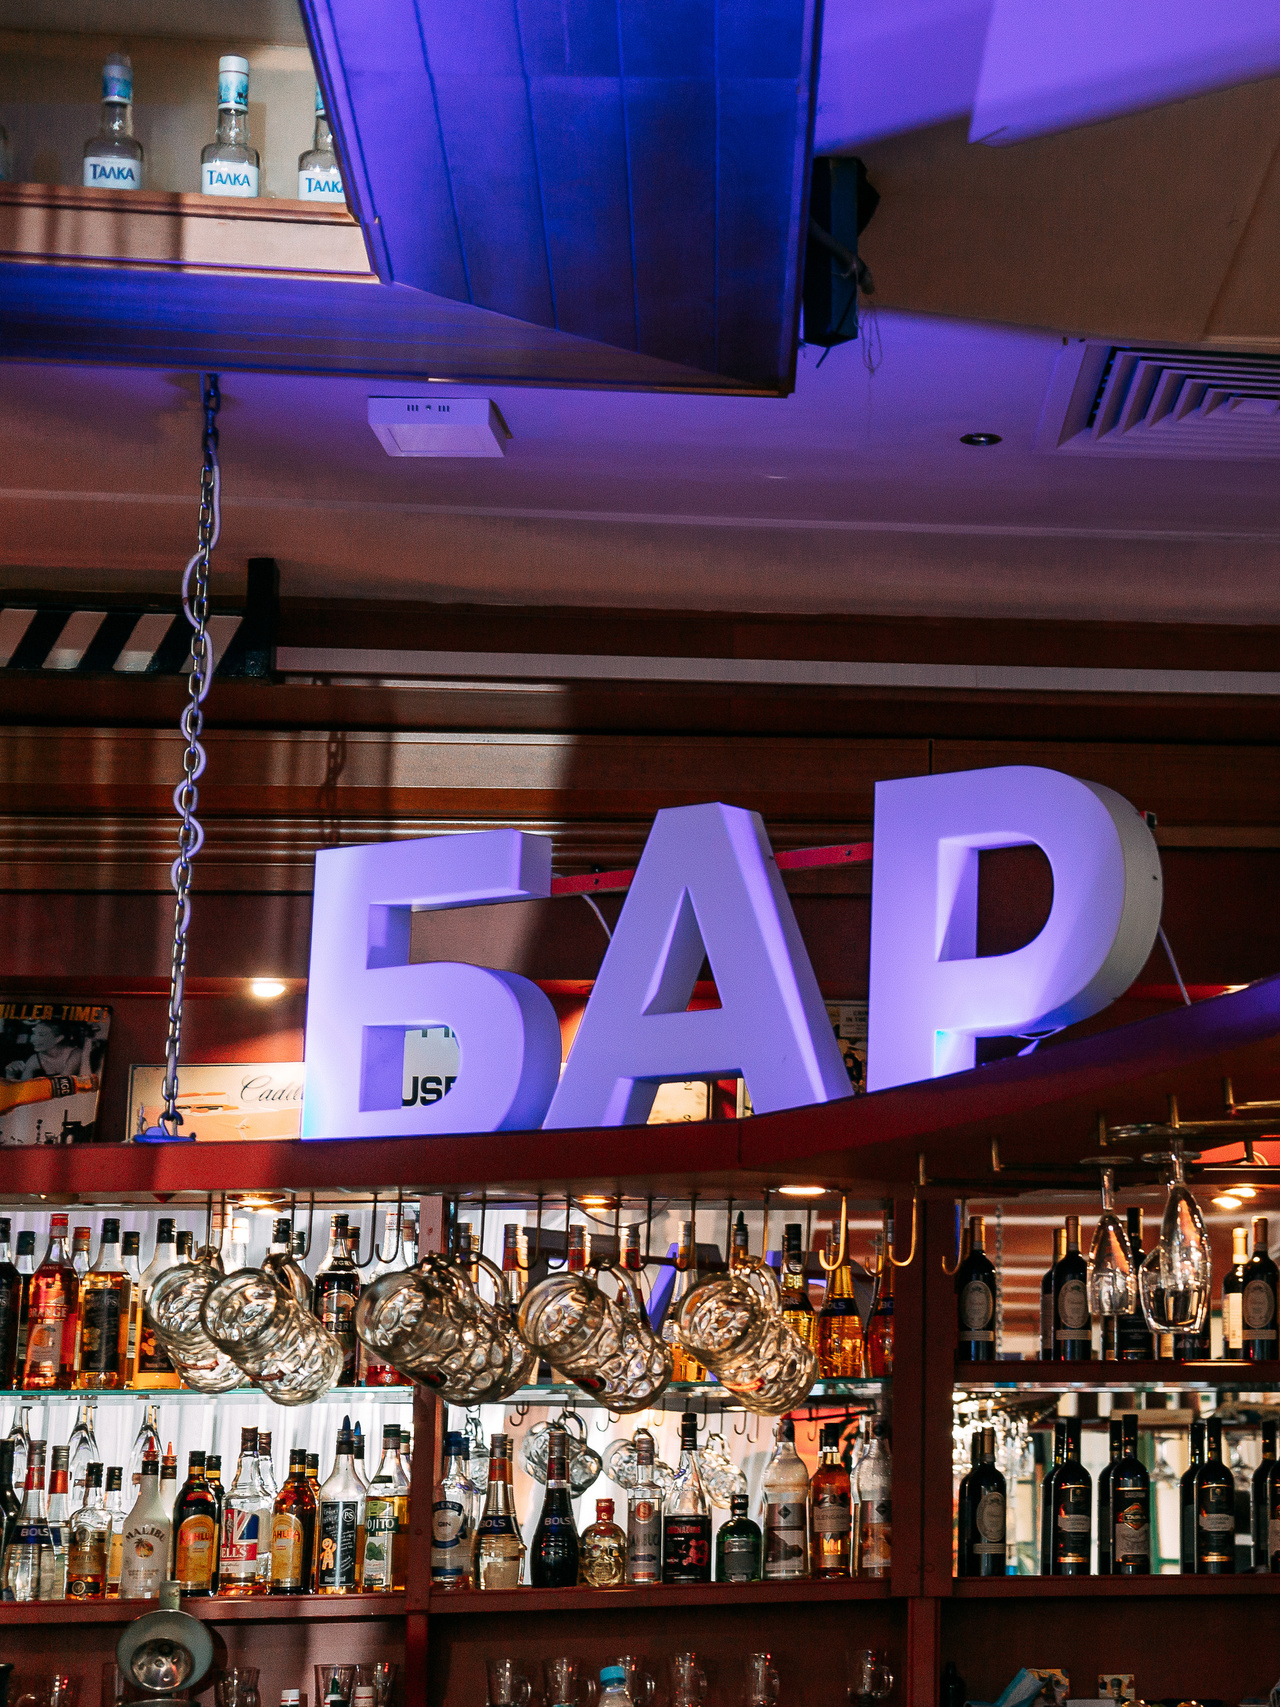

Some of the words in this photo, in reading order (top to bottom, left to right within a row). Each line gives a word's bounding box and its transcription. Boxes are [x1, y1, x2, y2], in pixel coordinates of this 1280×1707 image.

[206, 169, 251, 187] ТАЛКА
[302, 764, 1163, 1138] БАР
[61, 1005, 108, 1022] TIME!
[544, 1516, 572, 1526] BOLS
[20, 1528, 50, 1537] BOLS
